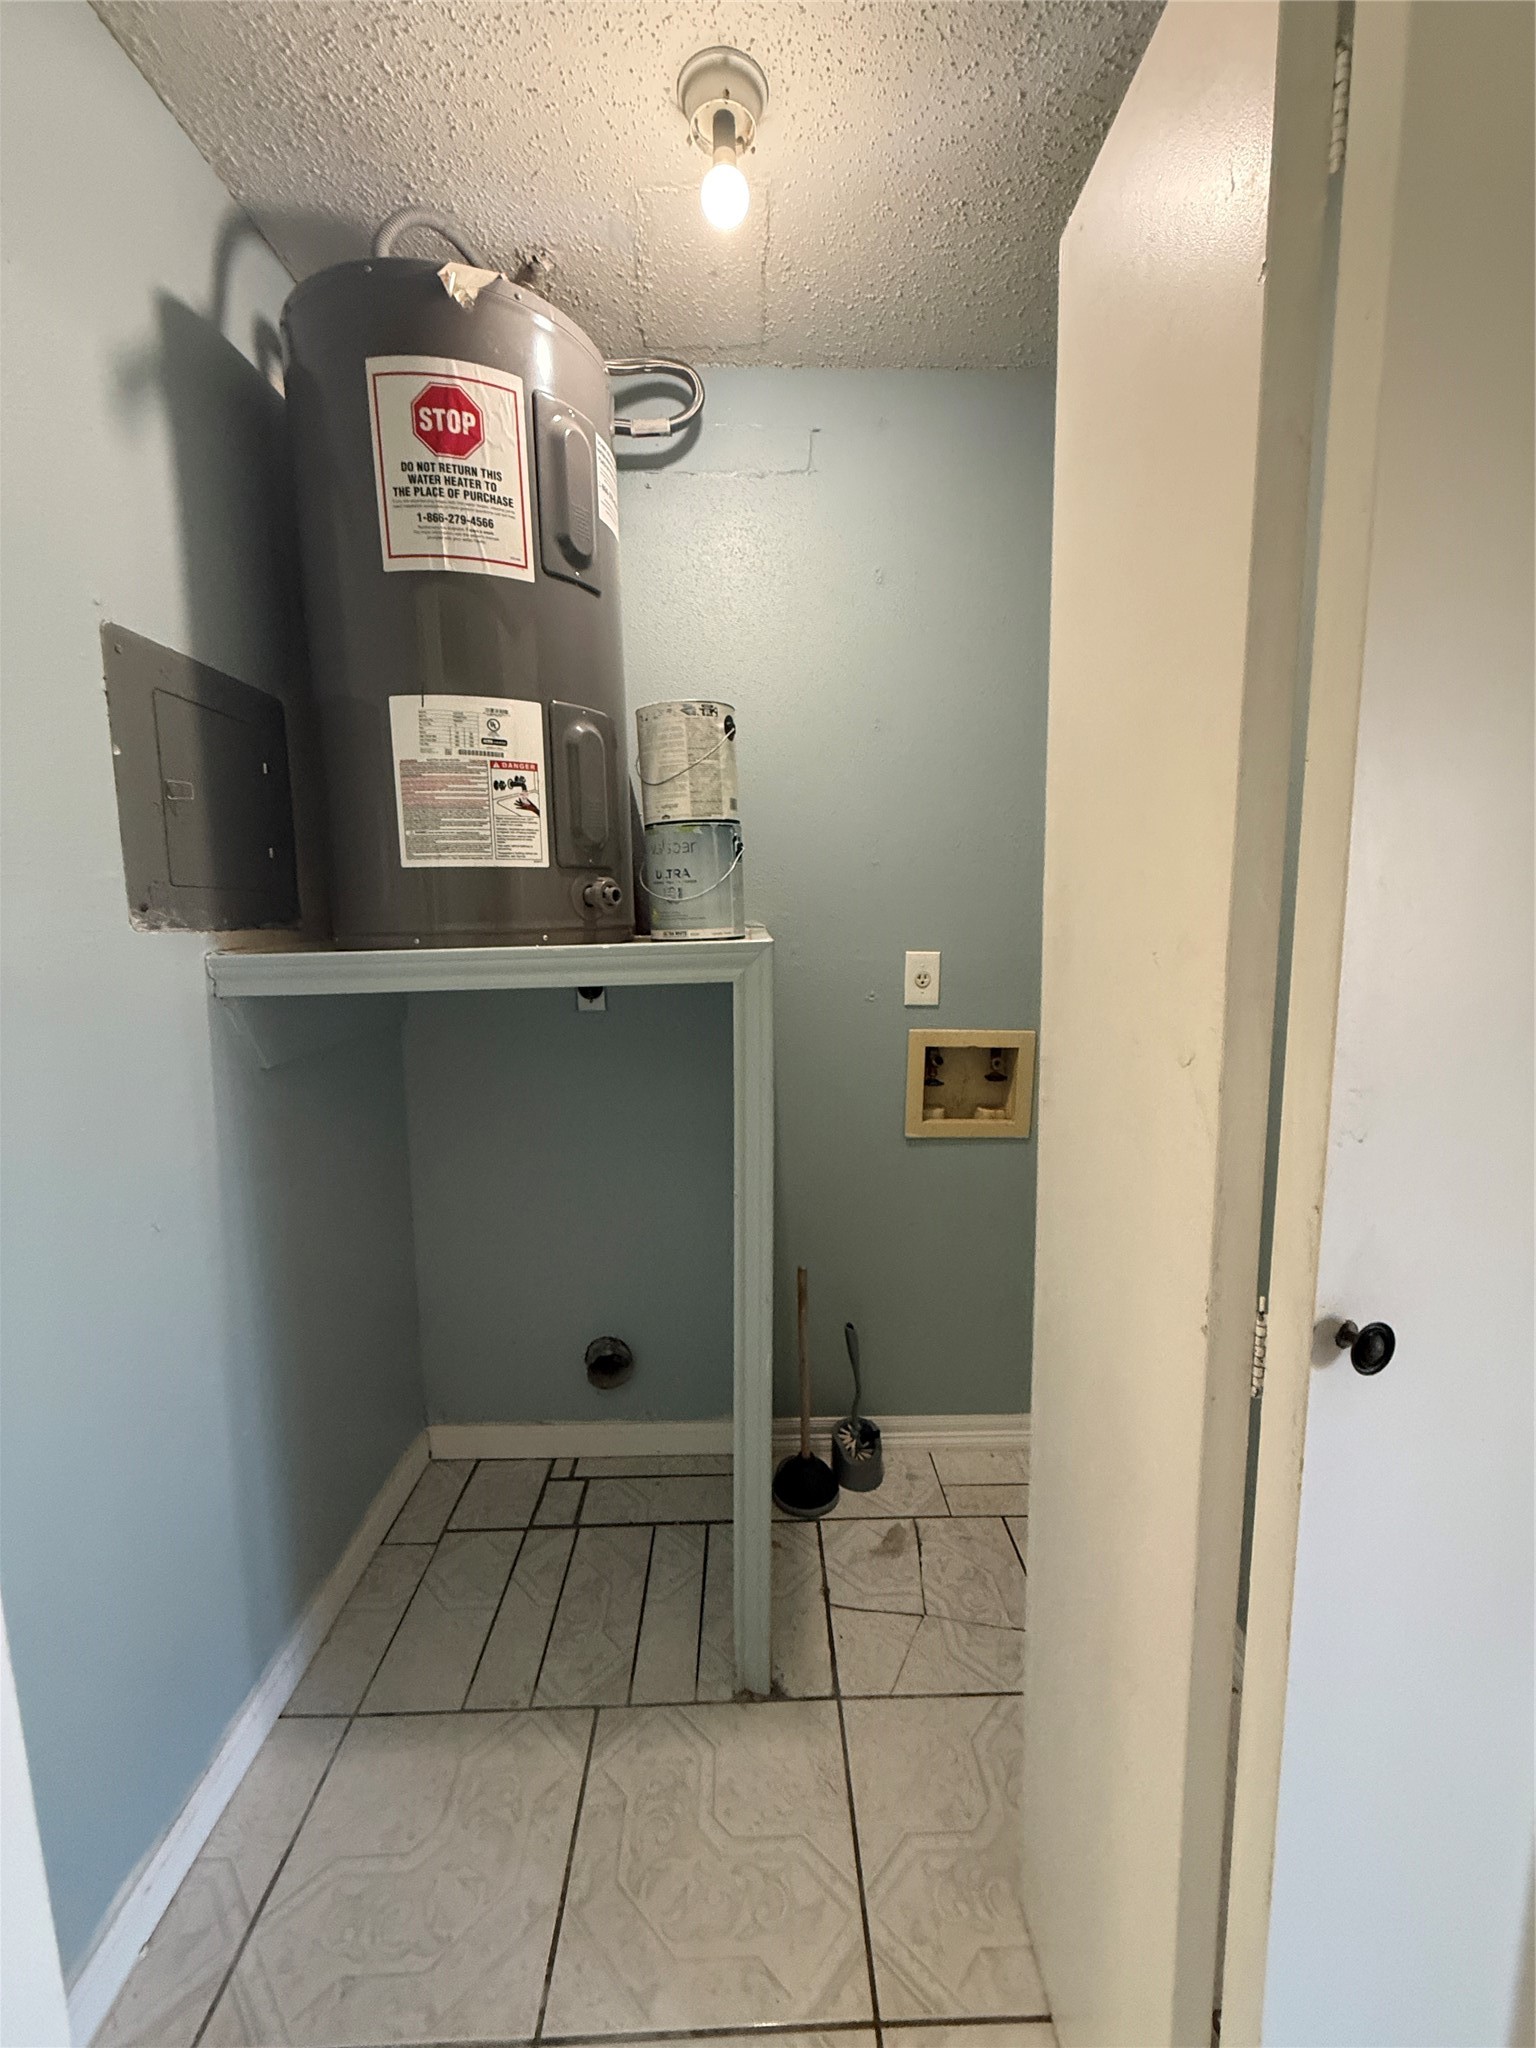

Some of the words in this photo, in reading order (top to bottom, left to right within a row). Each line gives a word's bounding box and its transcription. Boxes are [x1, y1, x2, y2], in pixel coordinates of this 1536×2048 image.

[419, 406, 476, 435] STOP
[400, 461, 414, 472] DO
[416, 462, 436, 472] NOT
[439, 462, 478, 477] RETURN
[480, 468, 503, 482] THIS
[407, 473, 441, 485] WATER
[443, 475, 482, 490] HEATER
[484, 480, 497, 492] TO
[392, 487, 411, 497] THE
[413, 487, 445, 498] PLACE
[447, 488, 460, 499] OF
[463, 489, 514, 508] PURCHASE
[416, 512, 494, 529] 1-866-279-4566
[501, 762, 536, 770] DANGER
